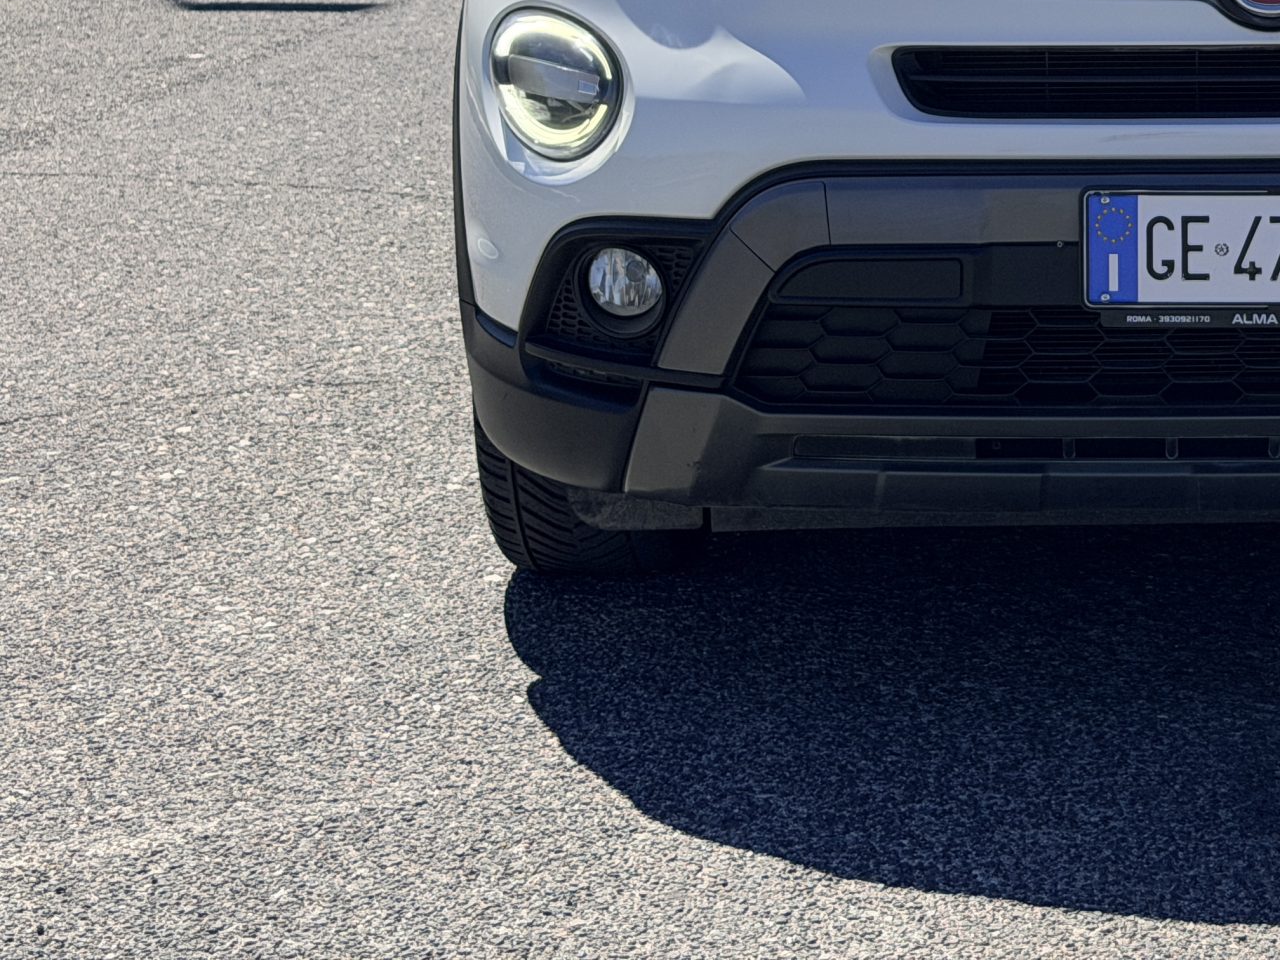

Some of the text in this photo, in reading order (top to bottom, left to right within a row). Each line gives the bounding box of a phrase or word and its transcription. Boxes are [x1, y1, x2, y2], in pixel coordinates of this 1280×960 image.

[1145, 215, 1211, 281] GE
[1126, 315, 1153, 323] ROMA
[1232, 313, 1279, 325] ALMA
